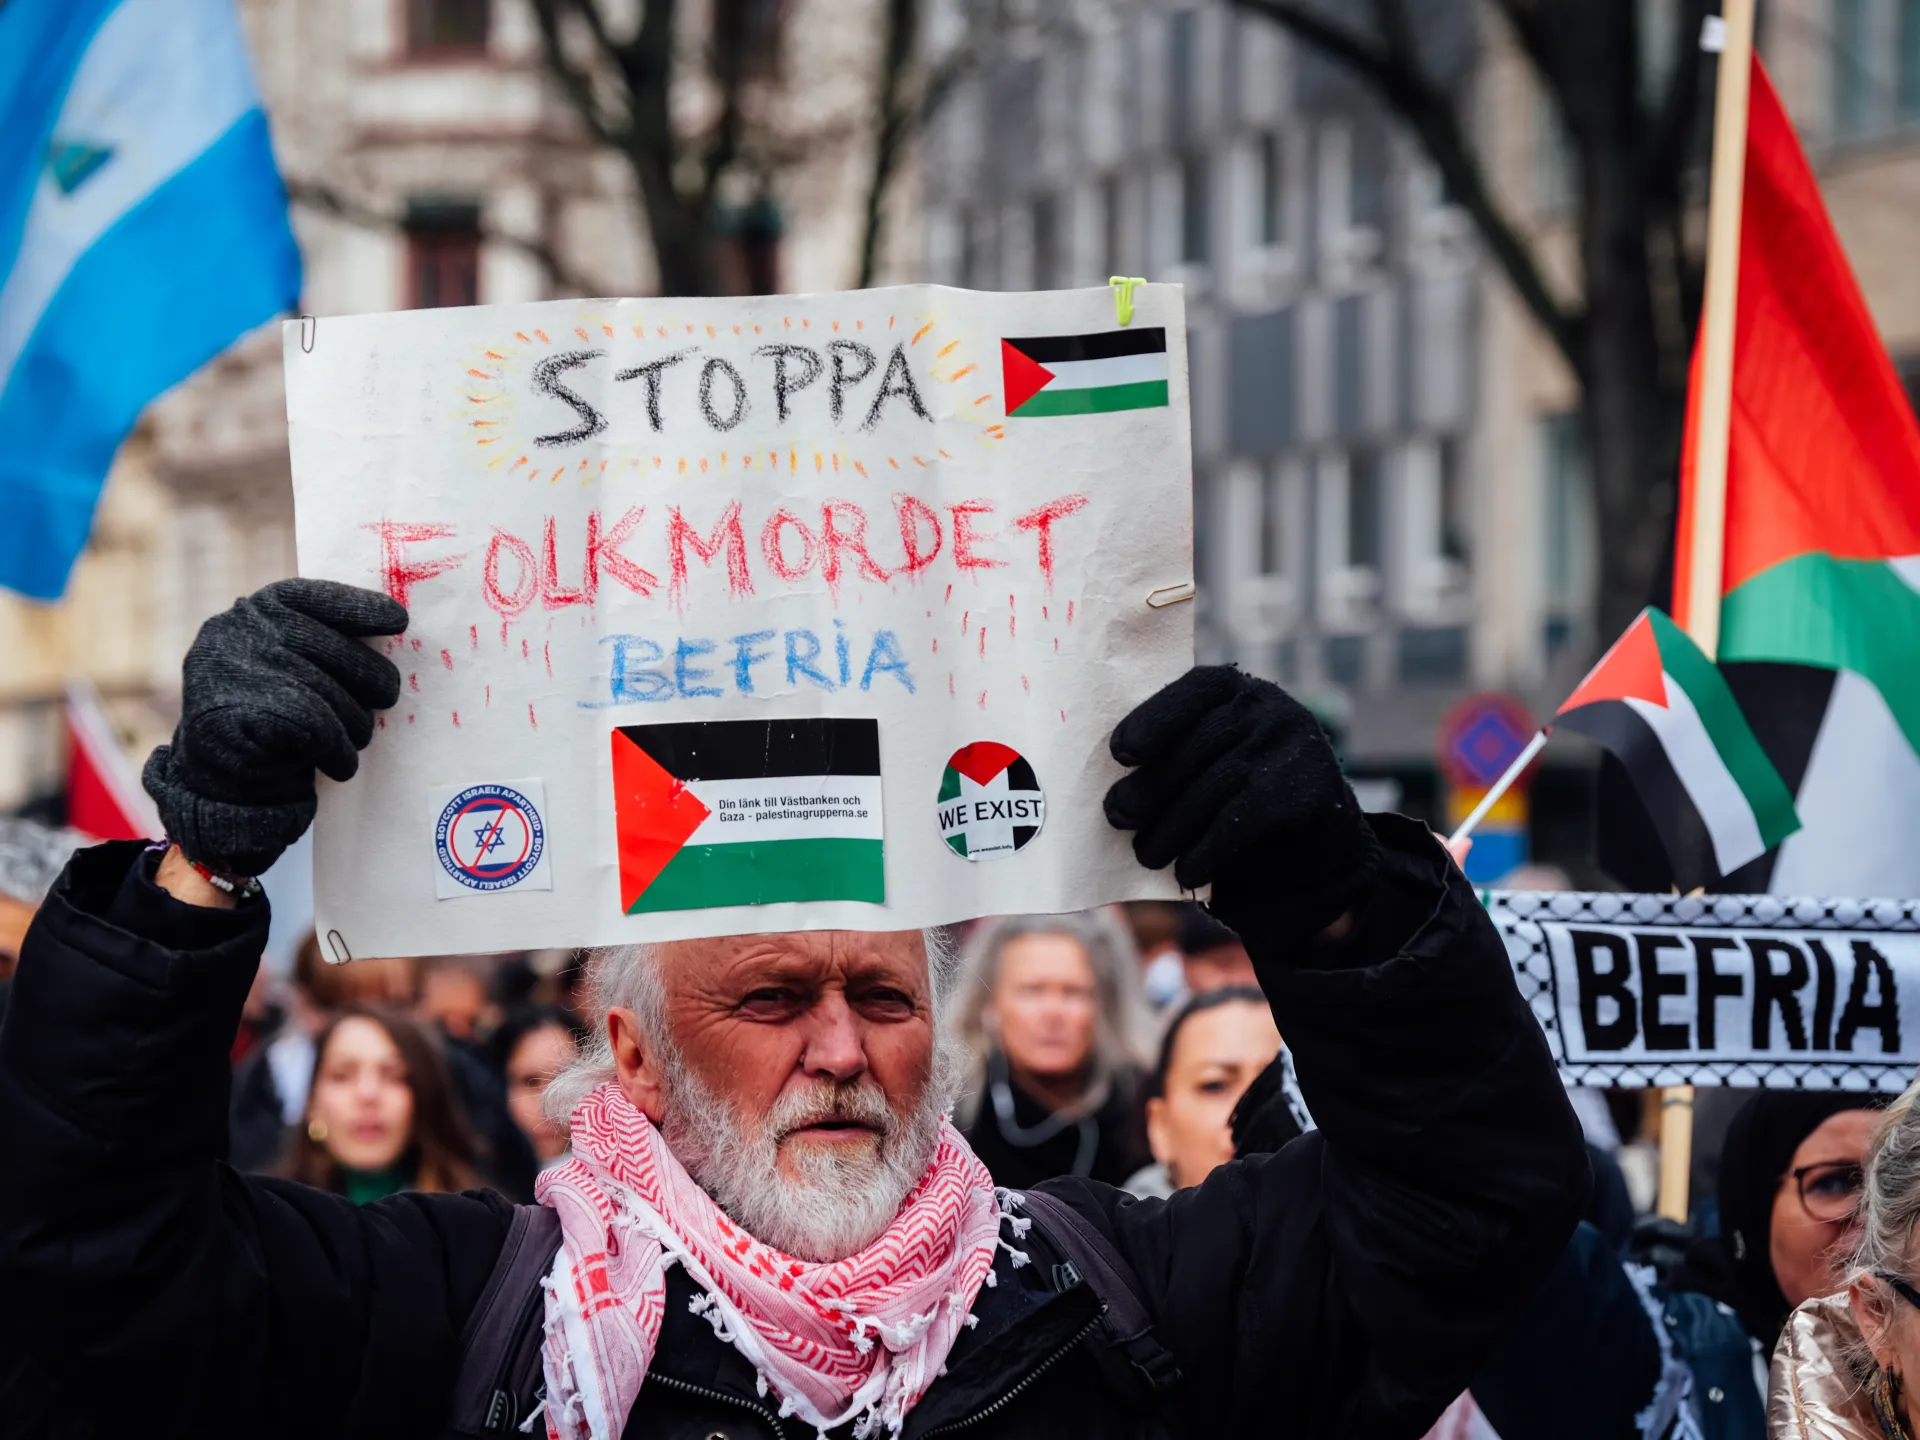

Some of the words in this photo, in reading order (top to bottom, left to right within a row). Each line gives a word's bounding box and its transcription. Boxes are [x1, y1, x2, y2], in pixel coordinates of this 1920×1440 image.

[532, 339, 935, 448] STOPPA
[364, 491, 1090, 617] FOLKMORDET
[437, 797, 462, 840] BOYCOTT
[462, 786, 501, 801] ISRAELI
[501, 789, 541, 833] APARTHEID
[719, 799, 736, 810] Din
[739, 797, 761, 809] länk
[764, 796, 777, 808] till
[780, 795, 840, 807] Västbanken
[842, 795, 861, 805] och
[719, 811, 745, 823] Gaza
[755, 808, 868, 823] palestinagrupperna.se
[939, 804, 968, 831] WE
[974, 799, 1042, 821] EXIST
[438, 846, 478, 888] APARTHEID
[517, 837, 543, 879] BOYCOTT
[478, 874, 517, 890] ISRAELI
[1570, 929, 1901, 1053] BEFRIA
